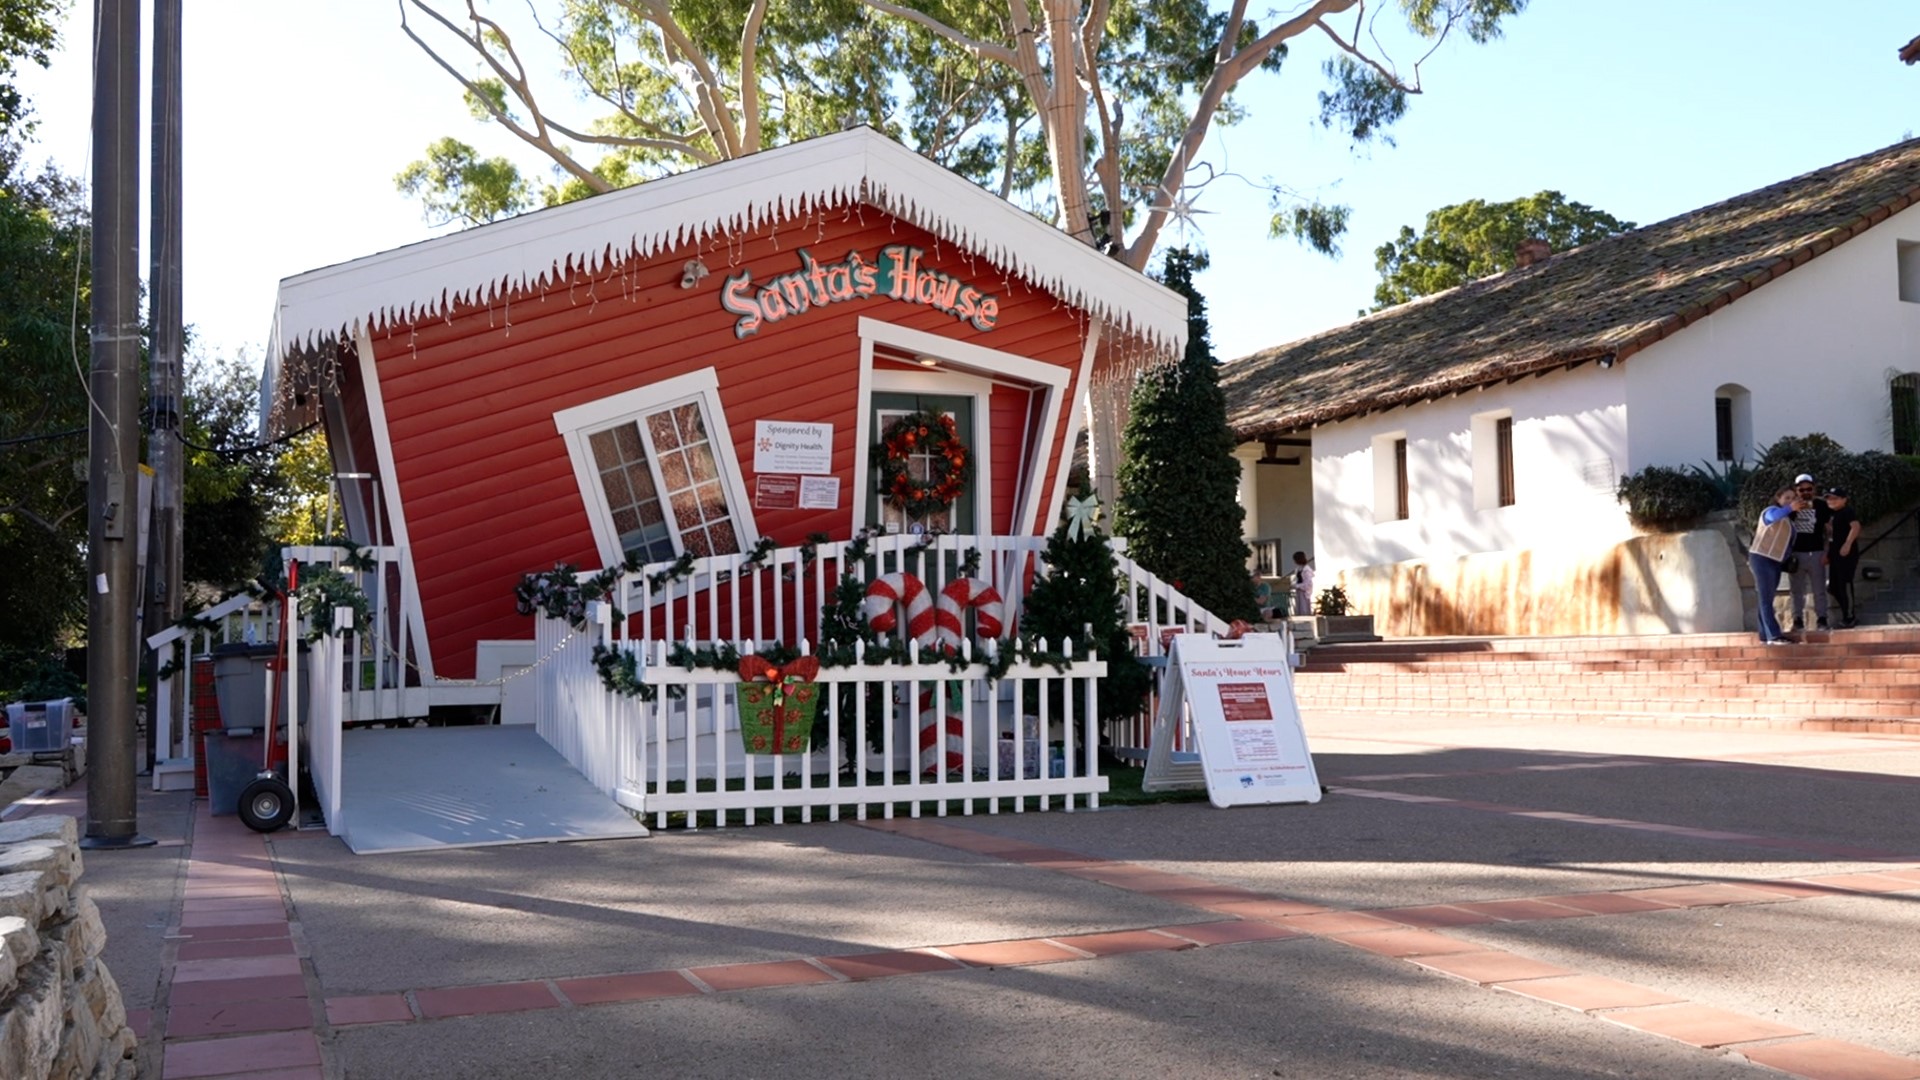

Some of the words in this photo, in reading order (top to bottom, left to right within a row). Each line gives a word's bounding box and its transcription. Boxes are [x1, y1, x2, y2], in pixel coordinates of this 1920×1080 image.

[722, 248, 879, 339] Santa's
[882, 245, 999, 332] House
[767, 424, 811, 436] Sponsored
[812, 426, 823, 438] by
[774, 441, 800, 451] Dignity
[800, 442, 823, 450] Health
[1191, 668, 1223, 677] Santa's
[1224, 667, 1252, 677] House
[1253, 667, 1282, 676] Hours
